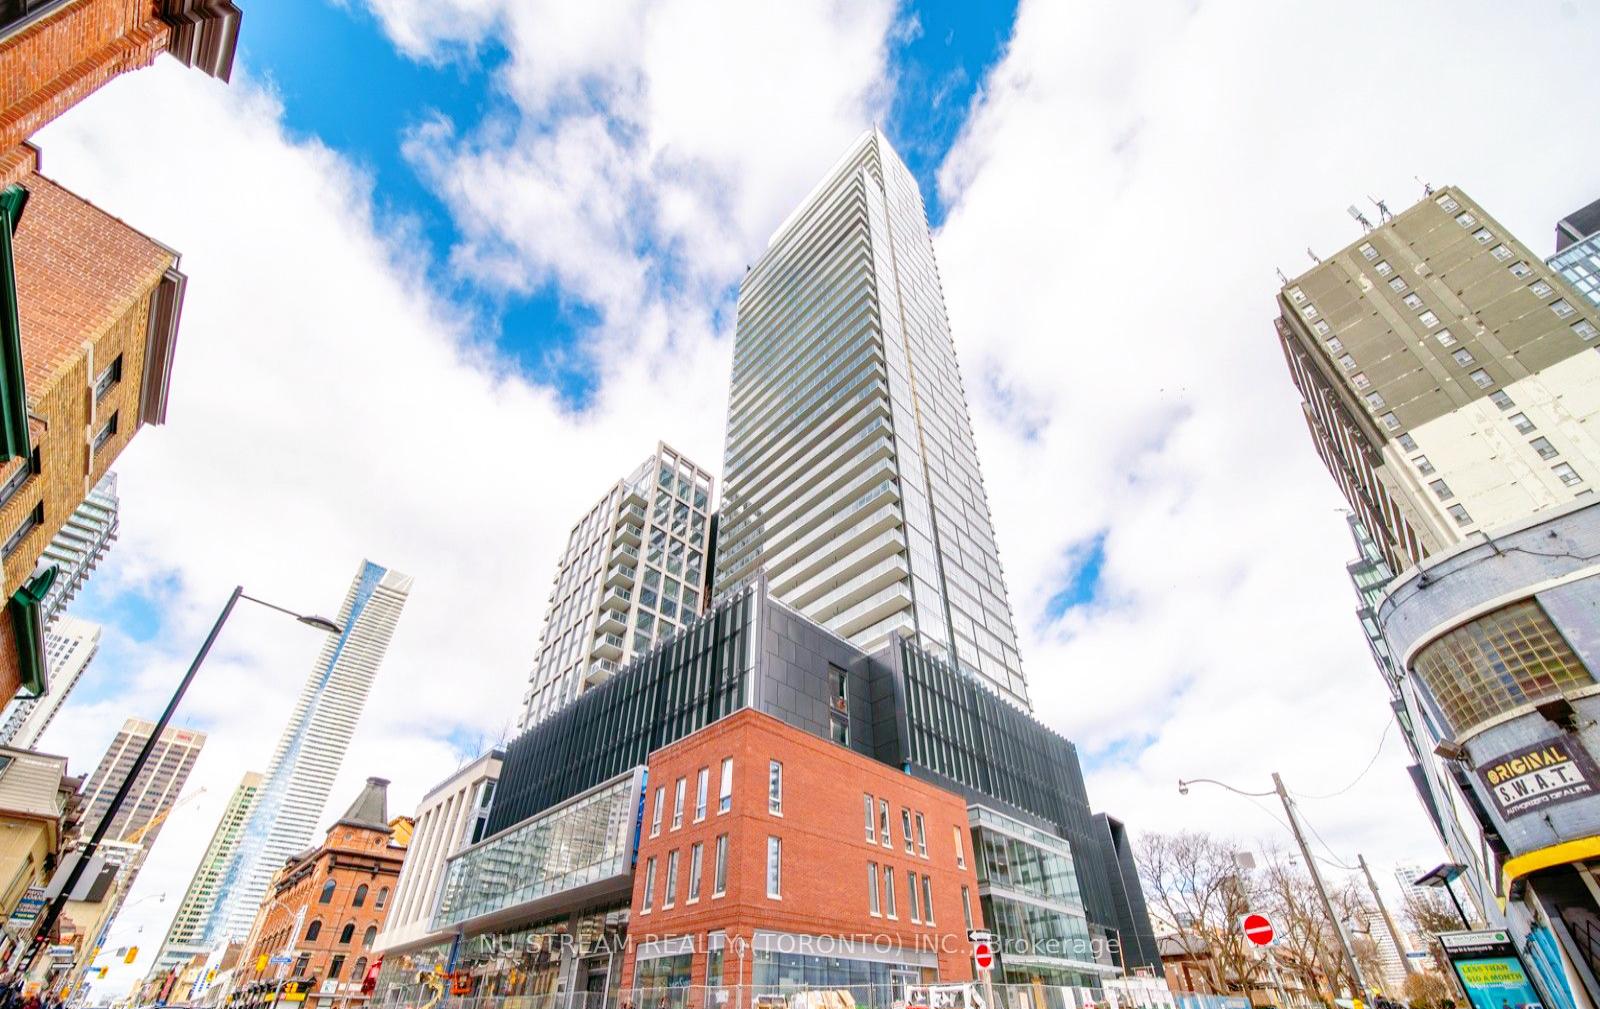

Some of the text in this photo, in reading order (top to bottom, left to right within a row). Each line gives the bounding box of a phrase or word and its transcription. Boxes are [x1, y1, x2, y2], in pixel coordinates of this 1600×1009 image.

[1487, 746, 1567, 785] ORIGINAL
[1499, 766, 1574, 802] S.W.A.T.
[1549, 784, 1592, 799] DEALER
